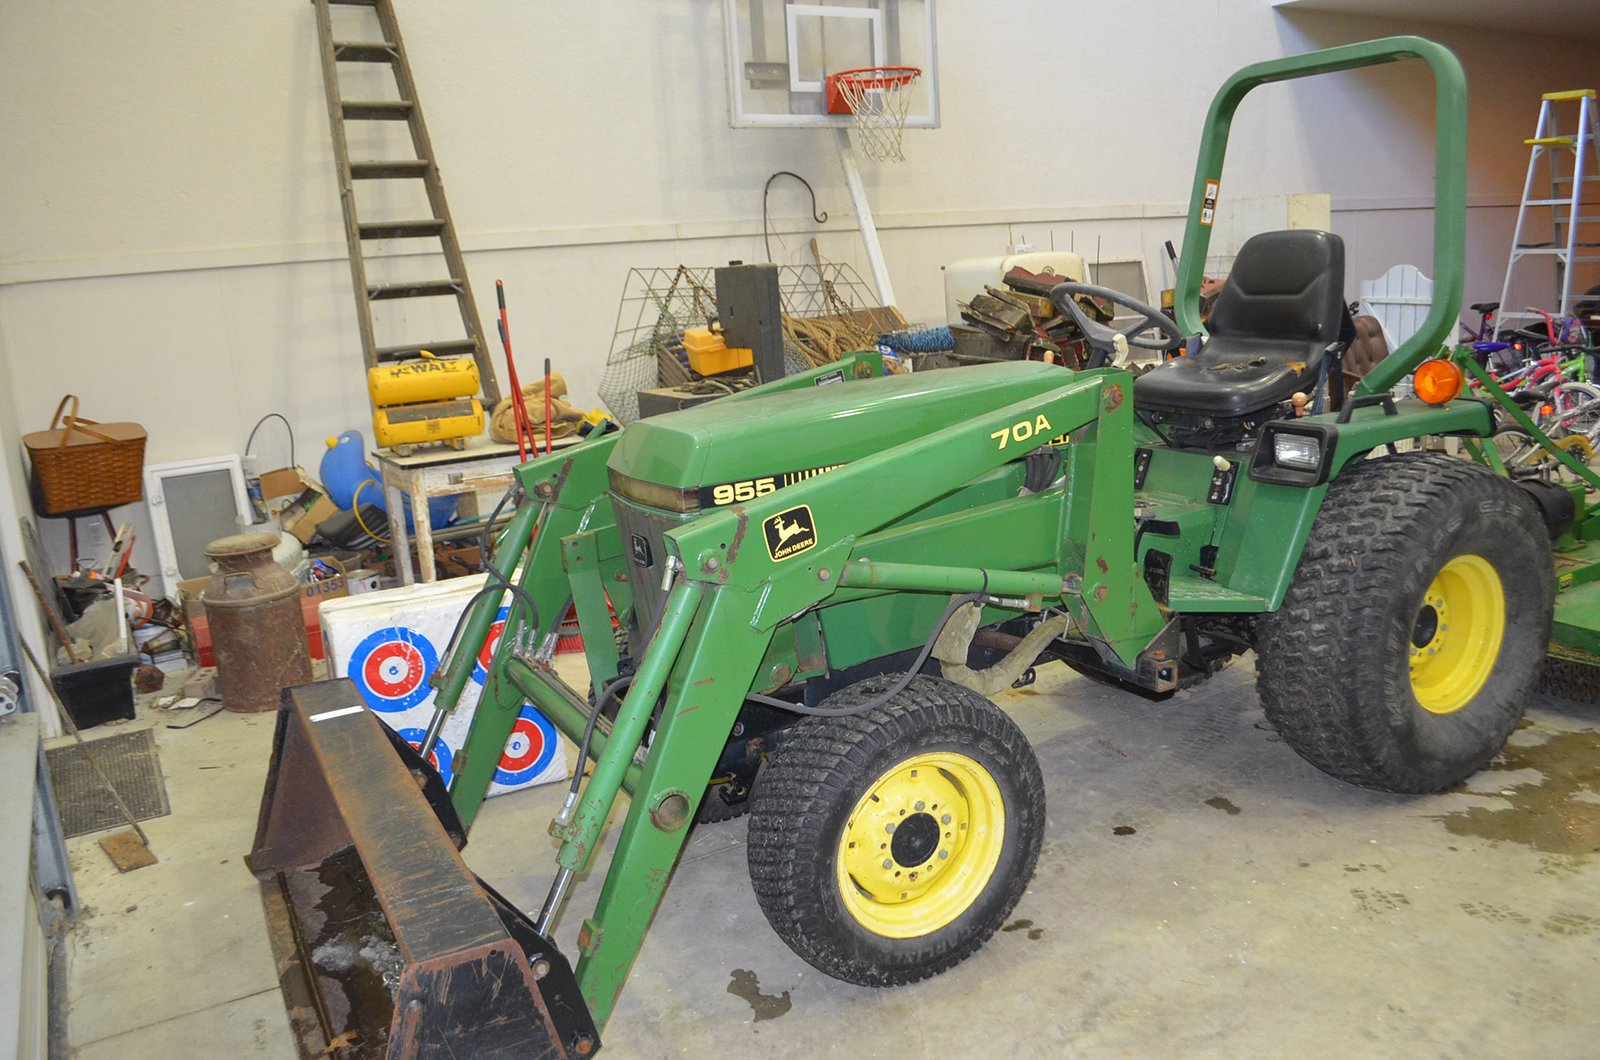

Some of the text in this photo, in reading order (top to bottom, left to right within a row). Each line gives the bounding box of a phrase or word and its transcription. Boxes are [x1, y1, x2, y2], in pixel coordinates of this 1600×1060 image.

[991, 414, 1052, 450] 70A
[713, 477, 776, 505] 955
[774, 538, 814, 559] JOHN DEERE
